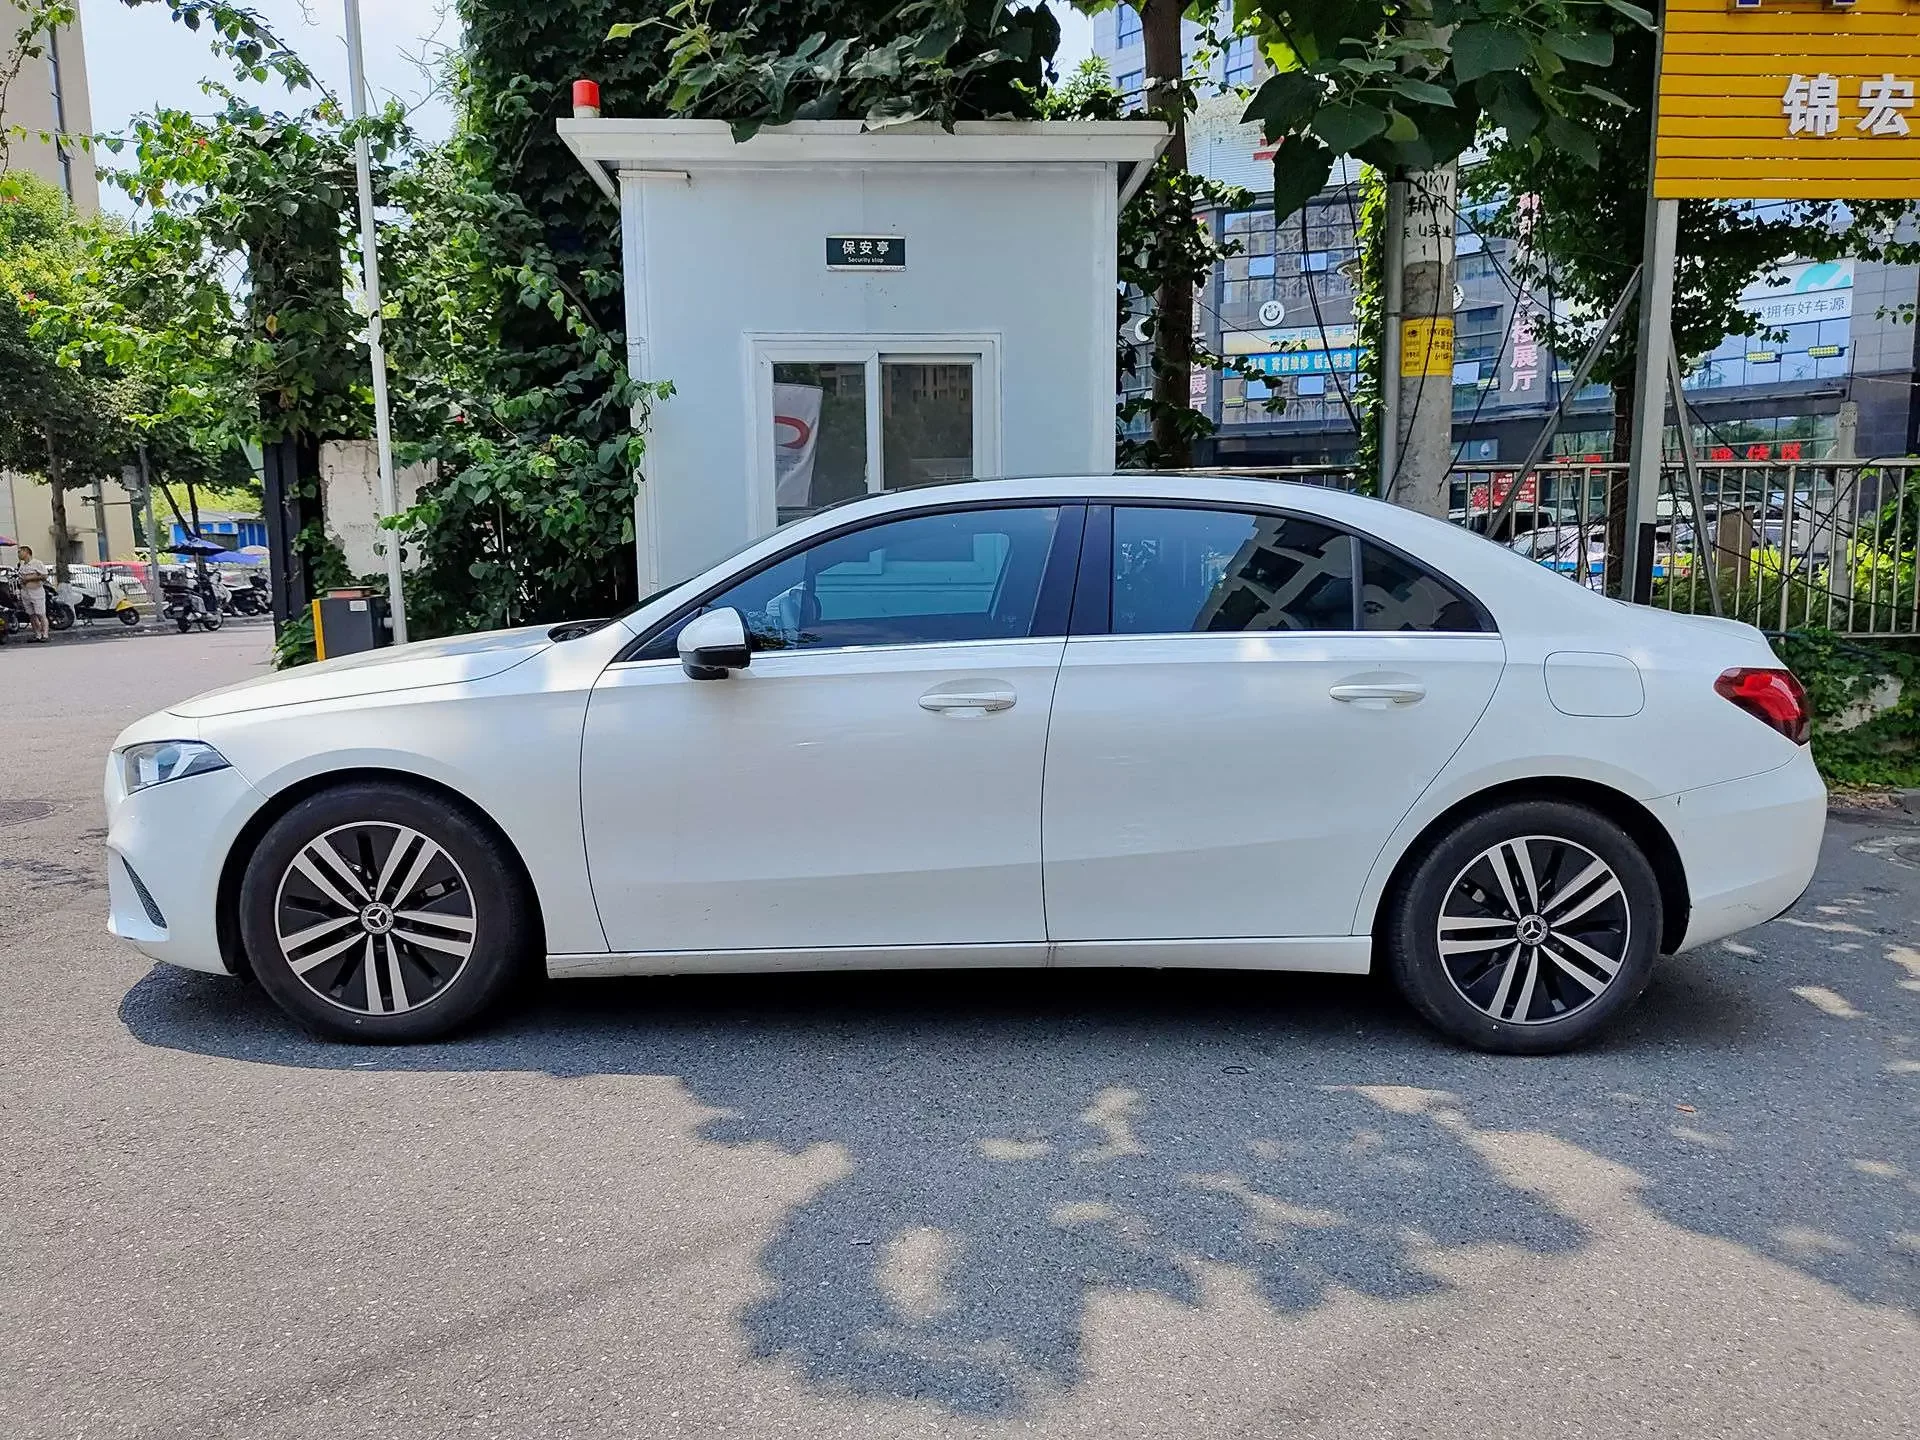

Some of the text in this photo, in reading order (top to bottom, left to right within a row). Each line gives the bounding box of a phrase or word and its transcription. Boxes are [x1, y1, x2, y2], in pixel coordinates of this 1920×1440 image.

[1782, 73, 1915, 137] 锦宏
[842, 240, 889, 255] 保安亭
